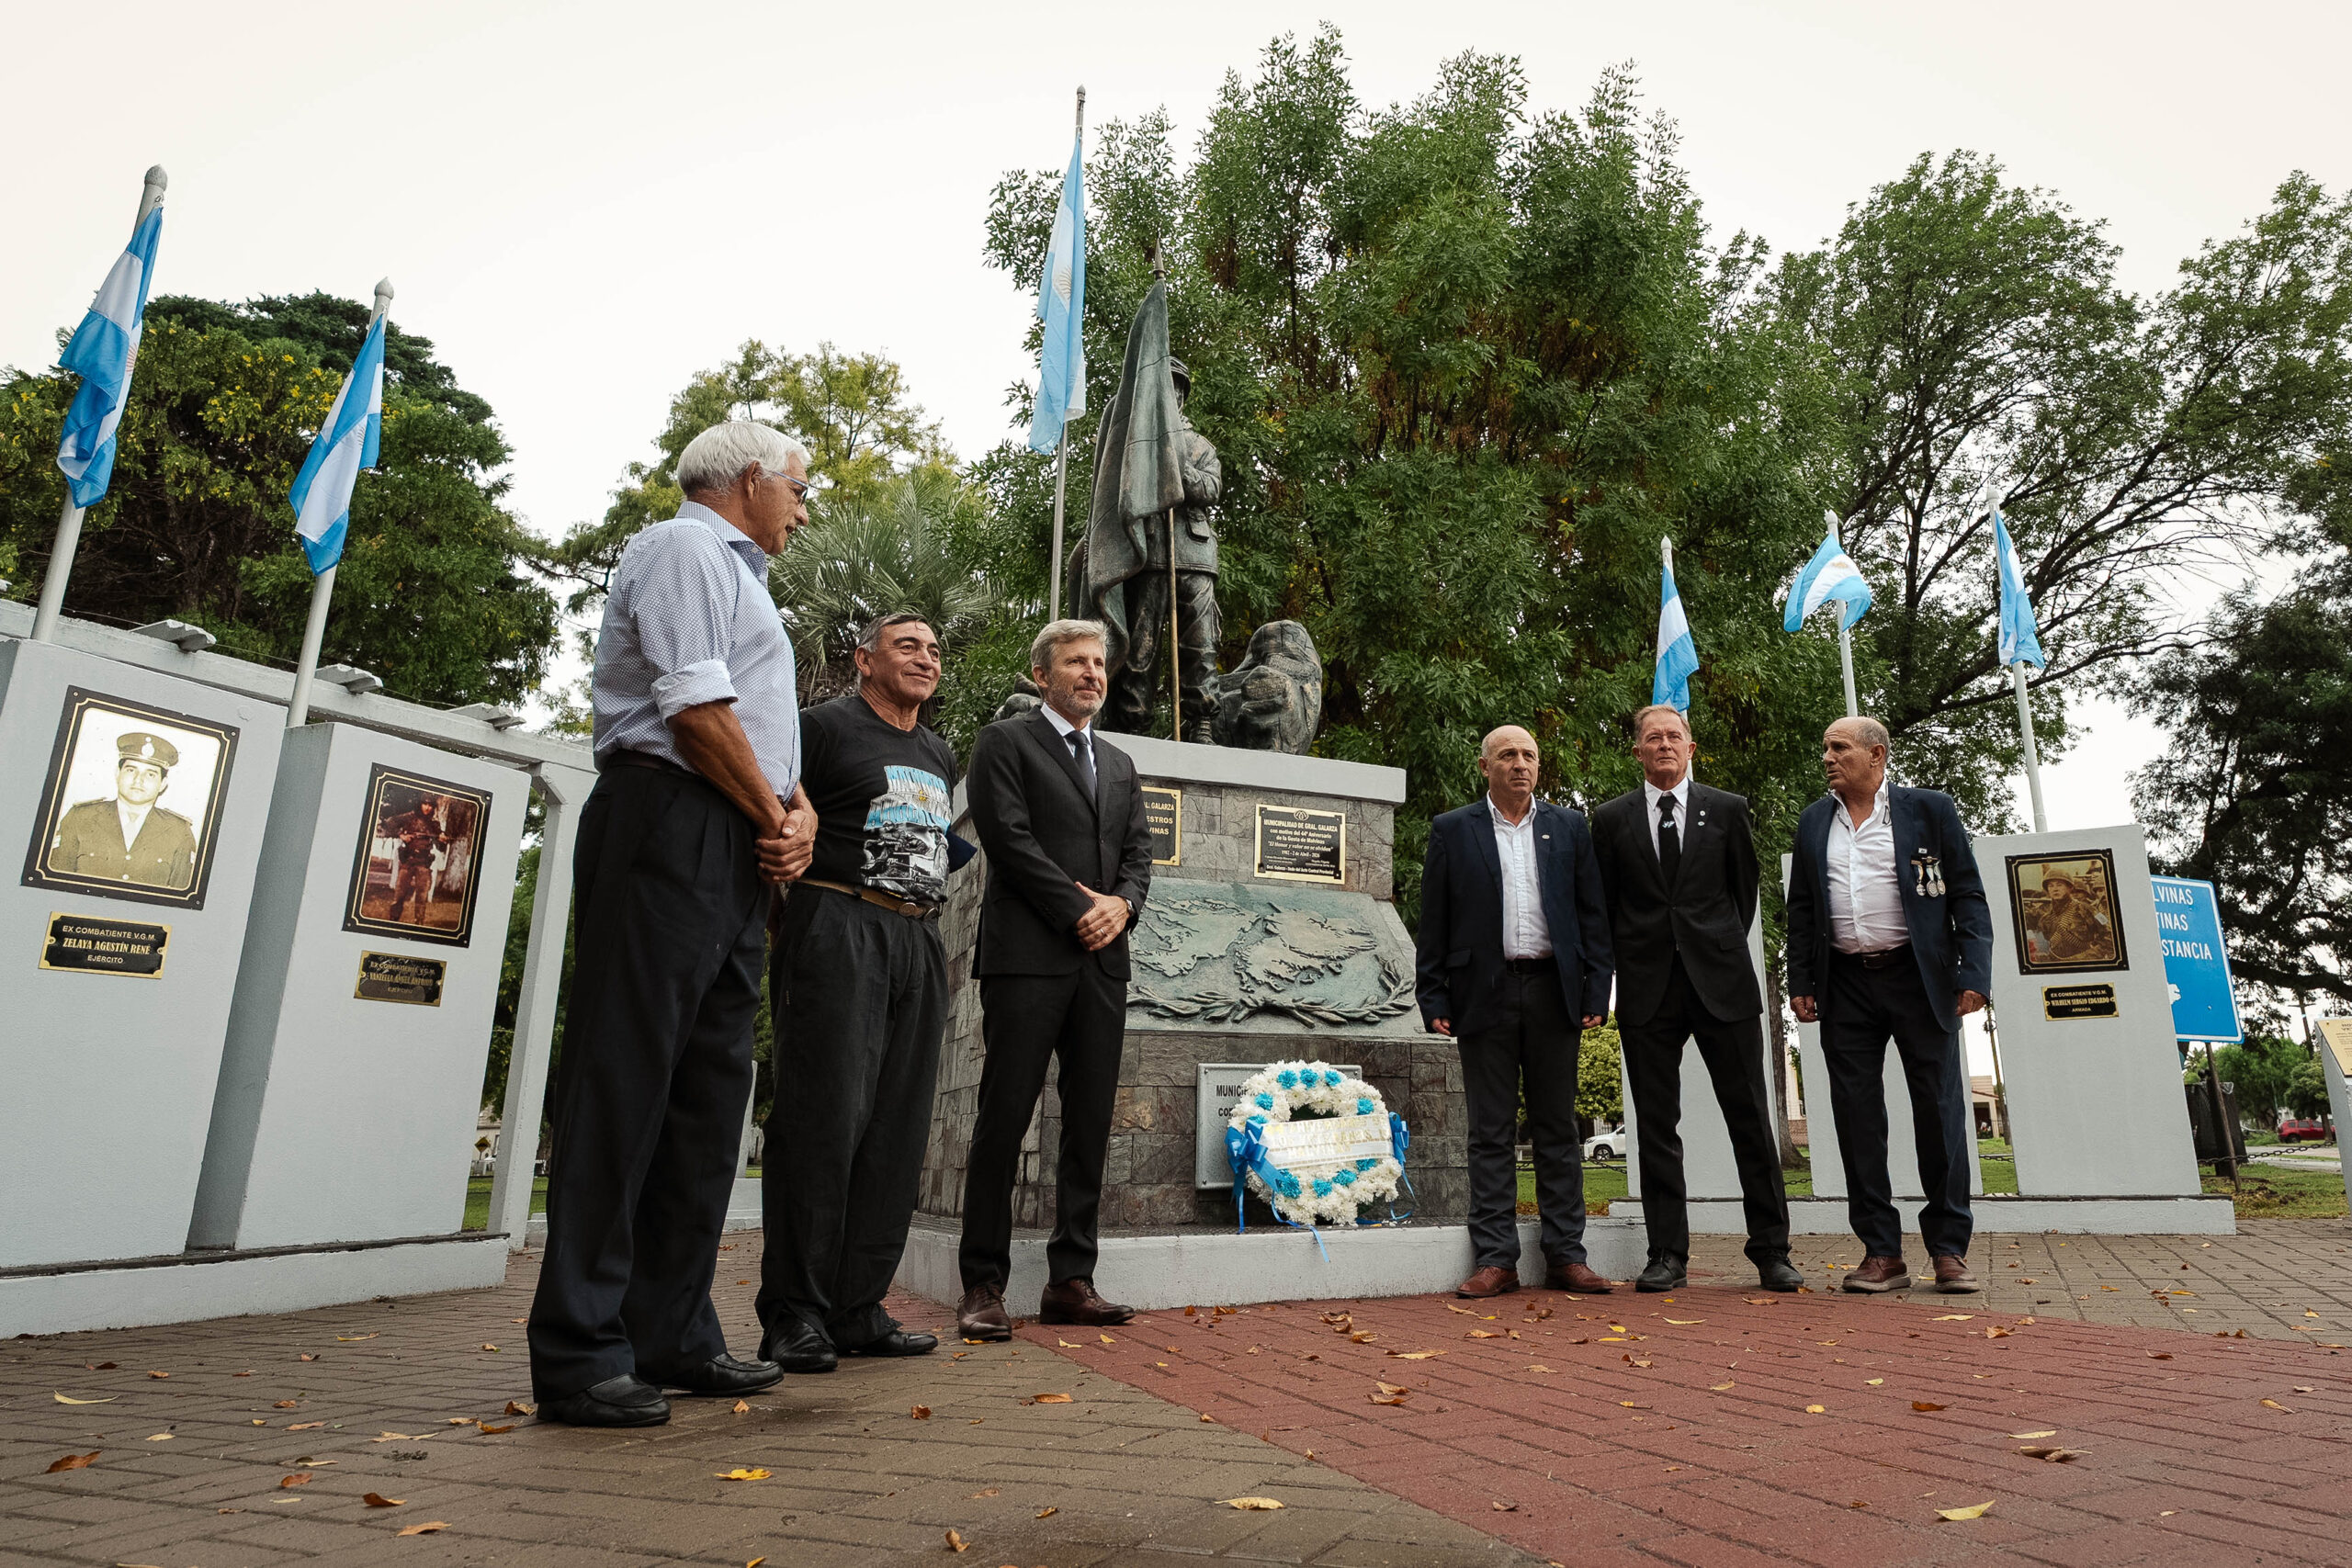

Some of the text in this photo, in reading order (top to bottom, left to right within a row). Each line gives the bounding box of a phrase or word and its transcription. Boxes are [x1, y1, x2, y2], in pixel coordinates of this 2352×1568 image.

[1263, 818, 1297, 829] MUNICIPALIDAD
[1317, 824, 1338, 832] GALARZA
[75, 926, 131, 939] COMBATIENTE
[133, 933, 156, 942] V.G.M.
[62, 937, 151, 955] ZELAYA AGUSTÍN RENÉ
[2161, 940, 2212, 960] STANCIA
